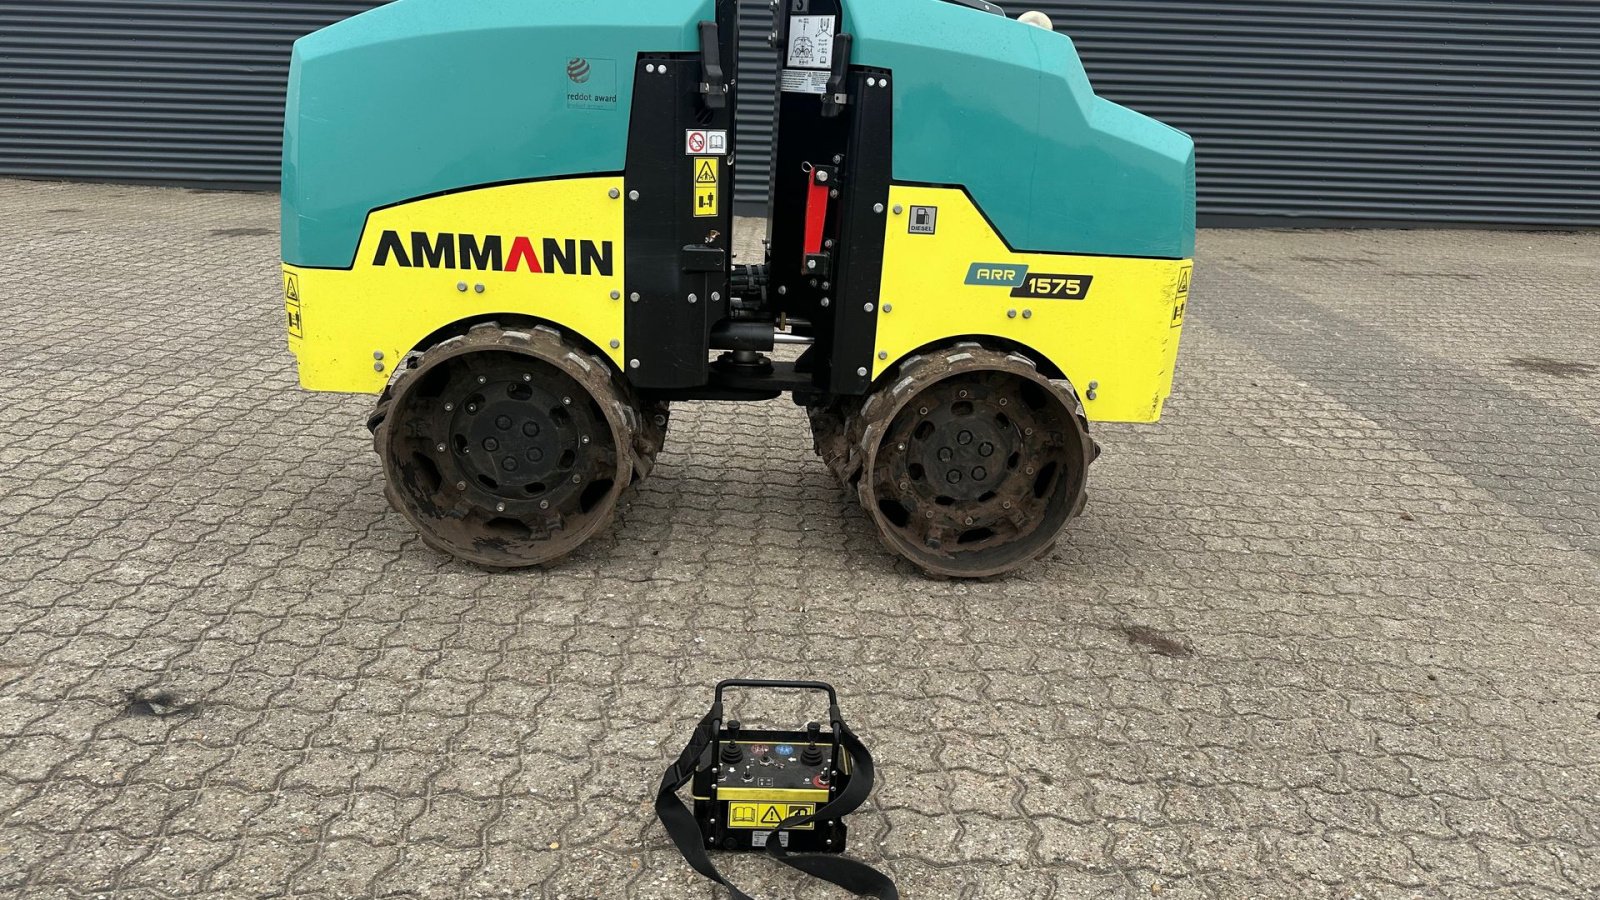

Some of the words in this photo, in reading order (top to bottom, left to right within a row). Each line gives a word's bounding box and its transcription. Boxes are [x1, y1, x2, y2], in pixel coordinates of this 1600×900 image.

[567, 93, 591, 101] reddot
[594, 94, 617, 103] award
[372, 230, 613, 277] AMMANN
[976, 268, 1016, 281] ARR
[1028, 278, 1081, 295] 1575
